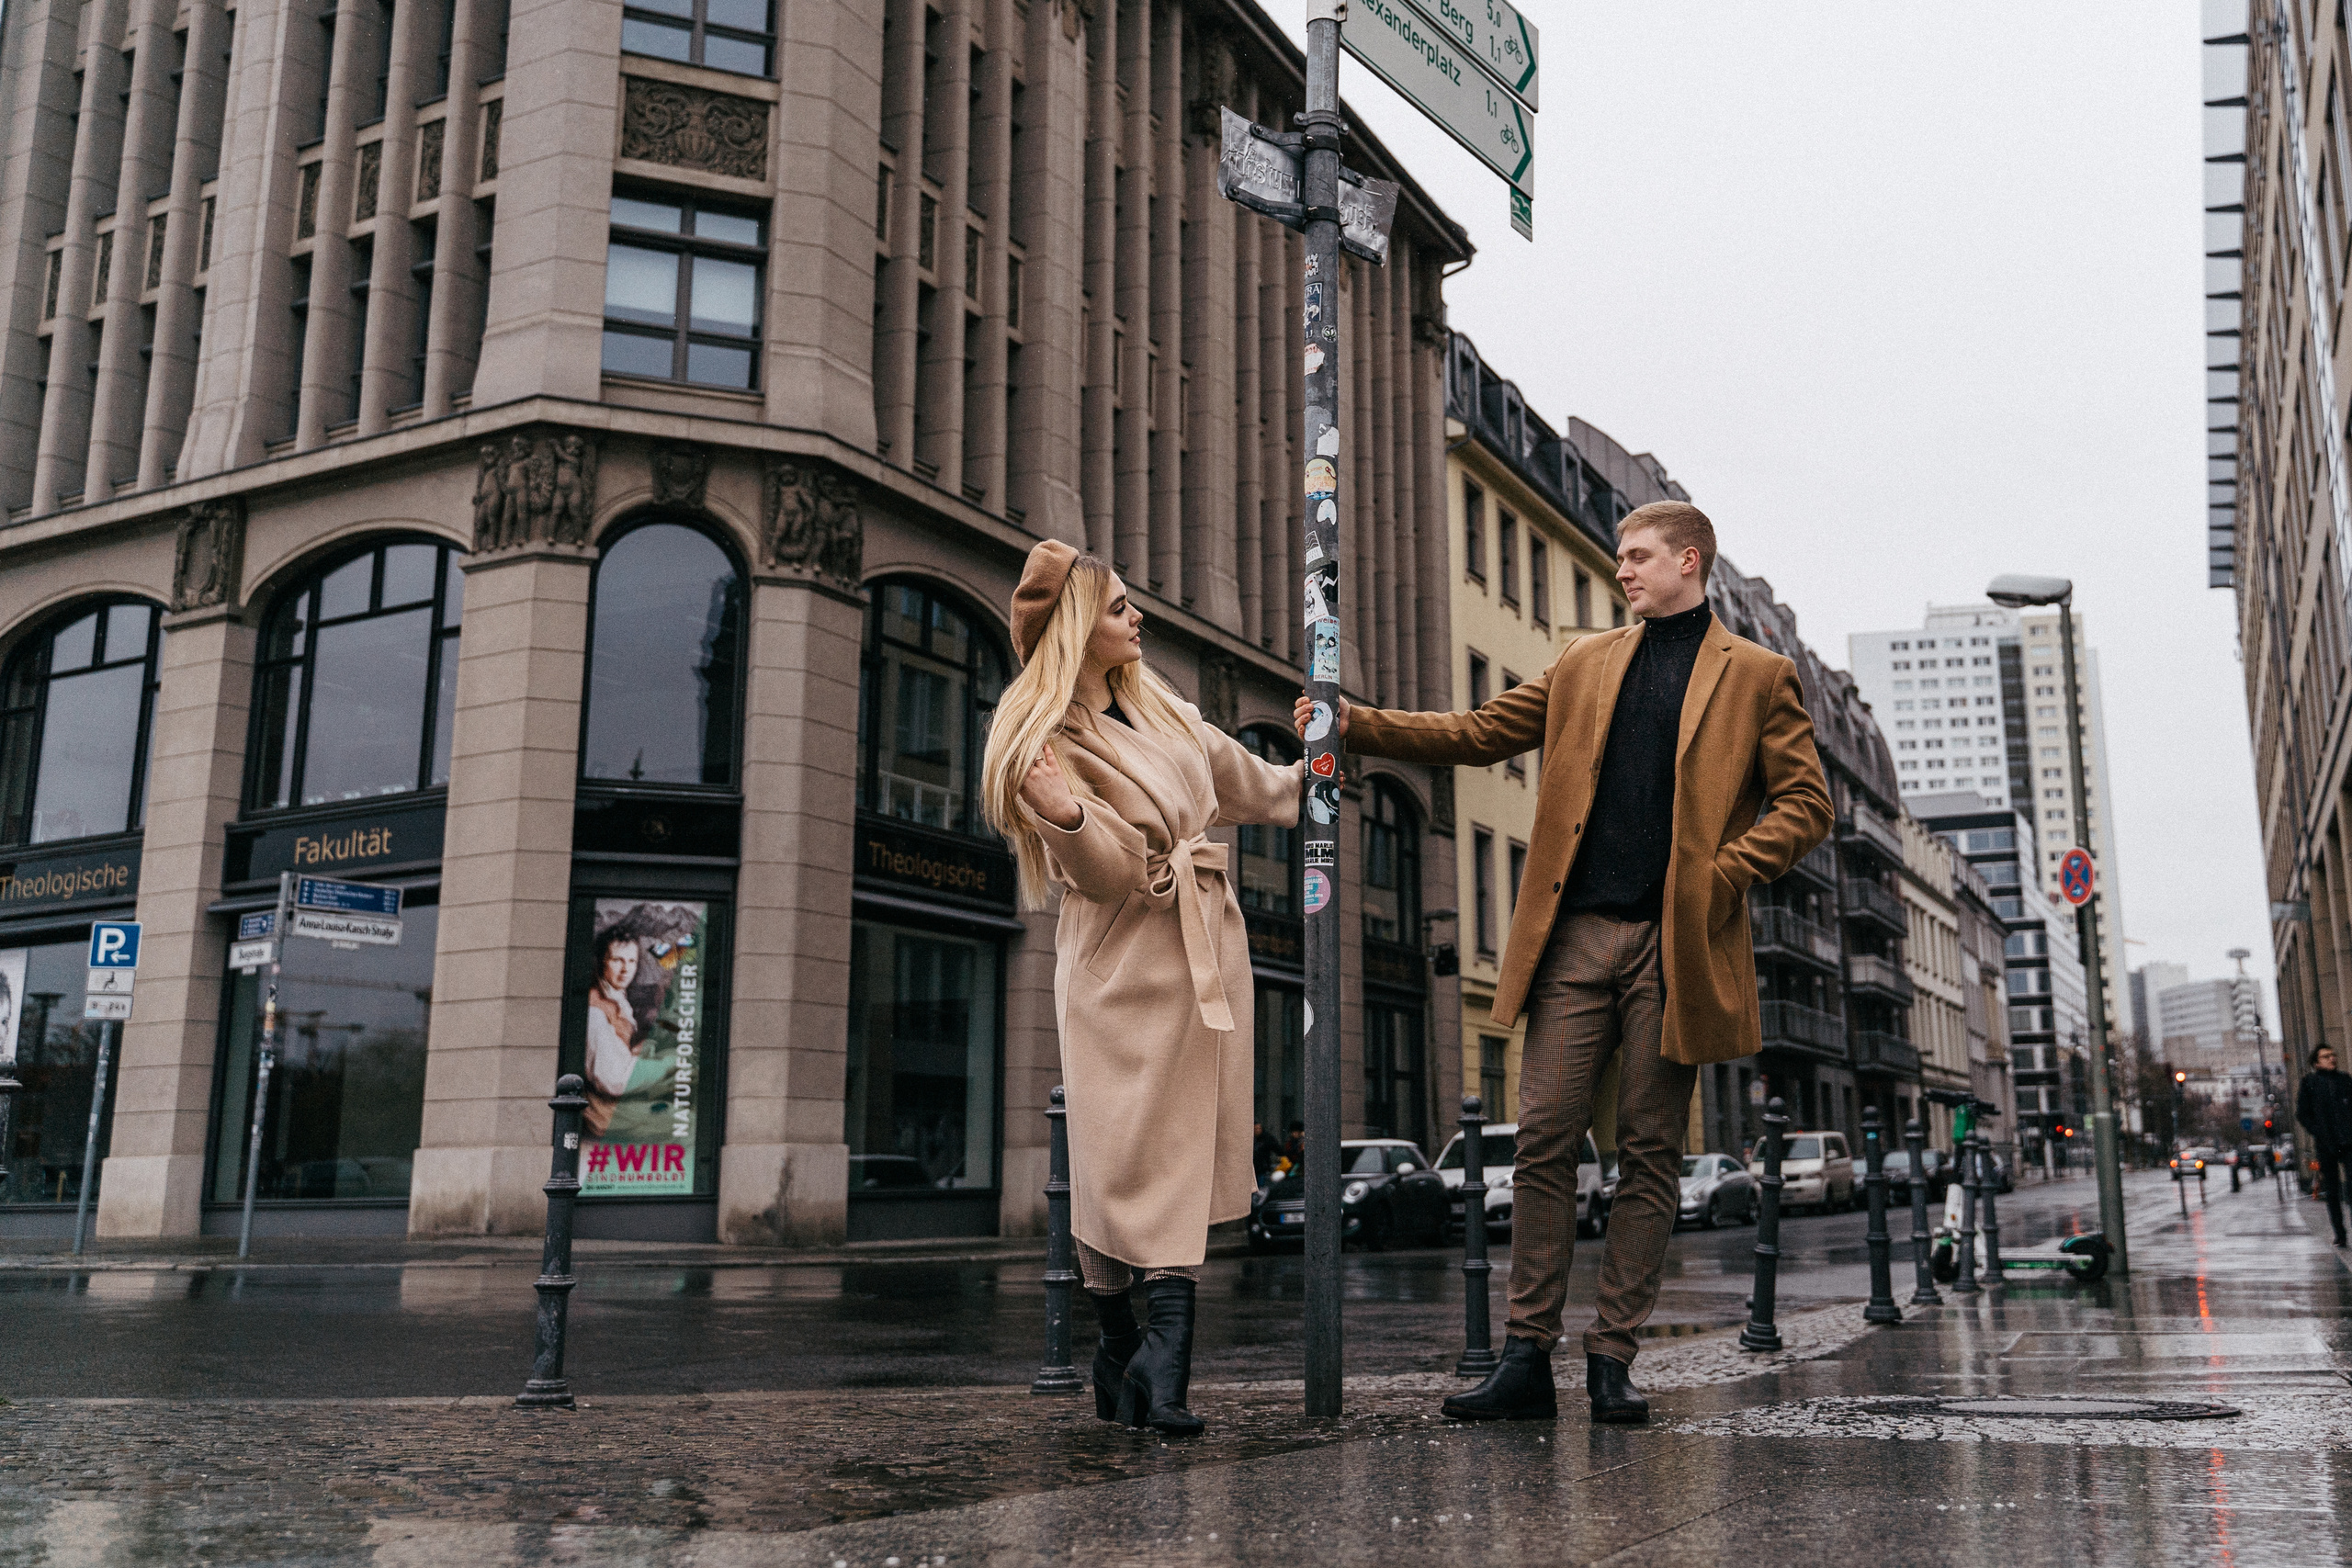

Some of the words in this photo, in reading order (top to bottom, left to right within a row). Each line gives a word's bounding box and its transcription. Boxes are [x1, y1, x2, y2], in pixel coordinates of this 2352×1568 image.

[1441, 0, 1474, 44] Berg
[1489, 35, 1501, 64] 1,1
[1362, 0, 1462, 87] exanderplatz
[1486, 89, 1498, 118] 1,1
[295, 827, 393, 865] Fakultät
[1306, 848, 1334, 858] MLM
[0, 863, 129, 900] Theologische
[868, 840, 988, 891] Theologische
[97, 927, 126, 964] P
[672, 964, 698, 1138] NATURFORSCHER
[588, 1144, 686, 1173] #WIR
